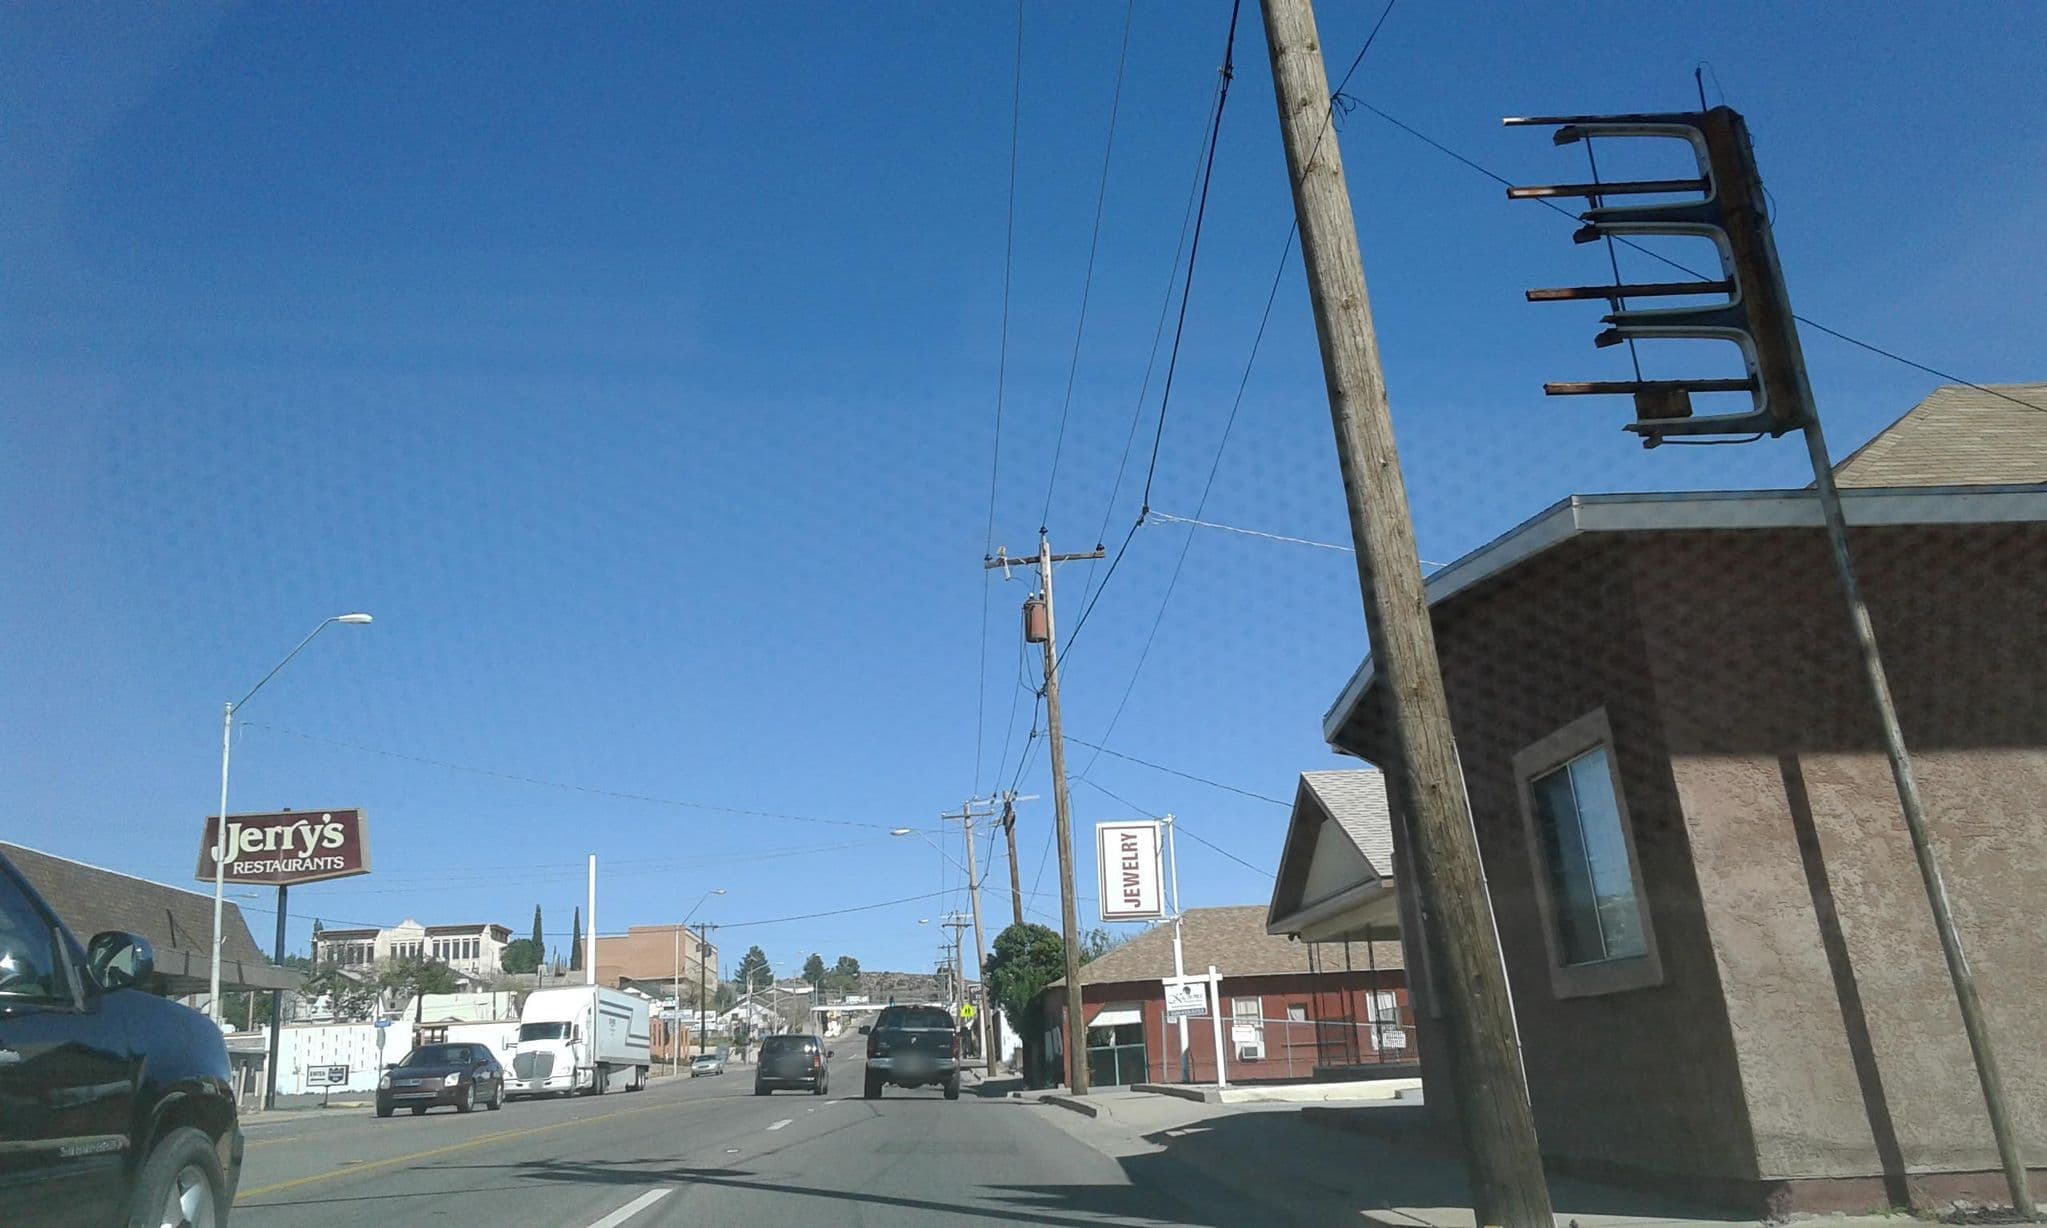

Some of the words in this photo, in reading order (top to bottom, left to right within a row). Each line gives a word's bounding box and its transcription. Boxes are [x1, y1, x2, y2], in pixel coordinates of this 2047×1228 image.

[211, 813, 345, 864] Jerry's
[232, 856, 345, 875] RESTAURANTS
[1120, 832, 1141, 908] JEWELRY
